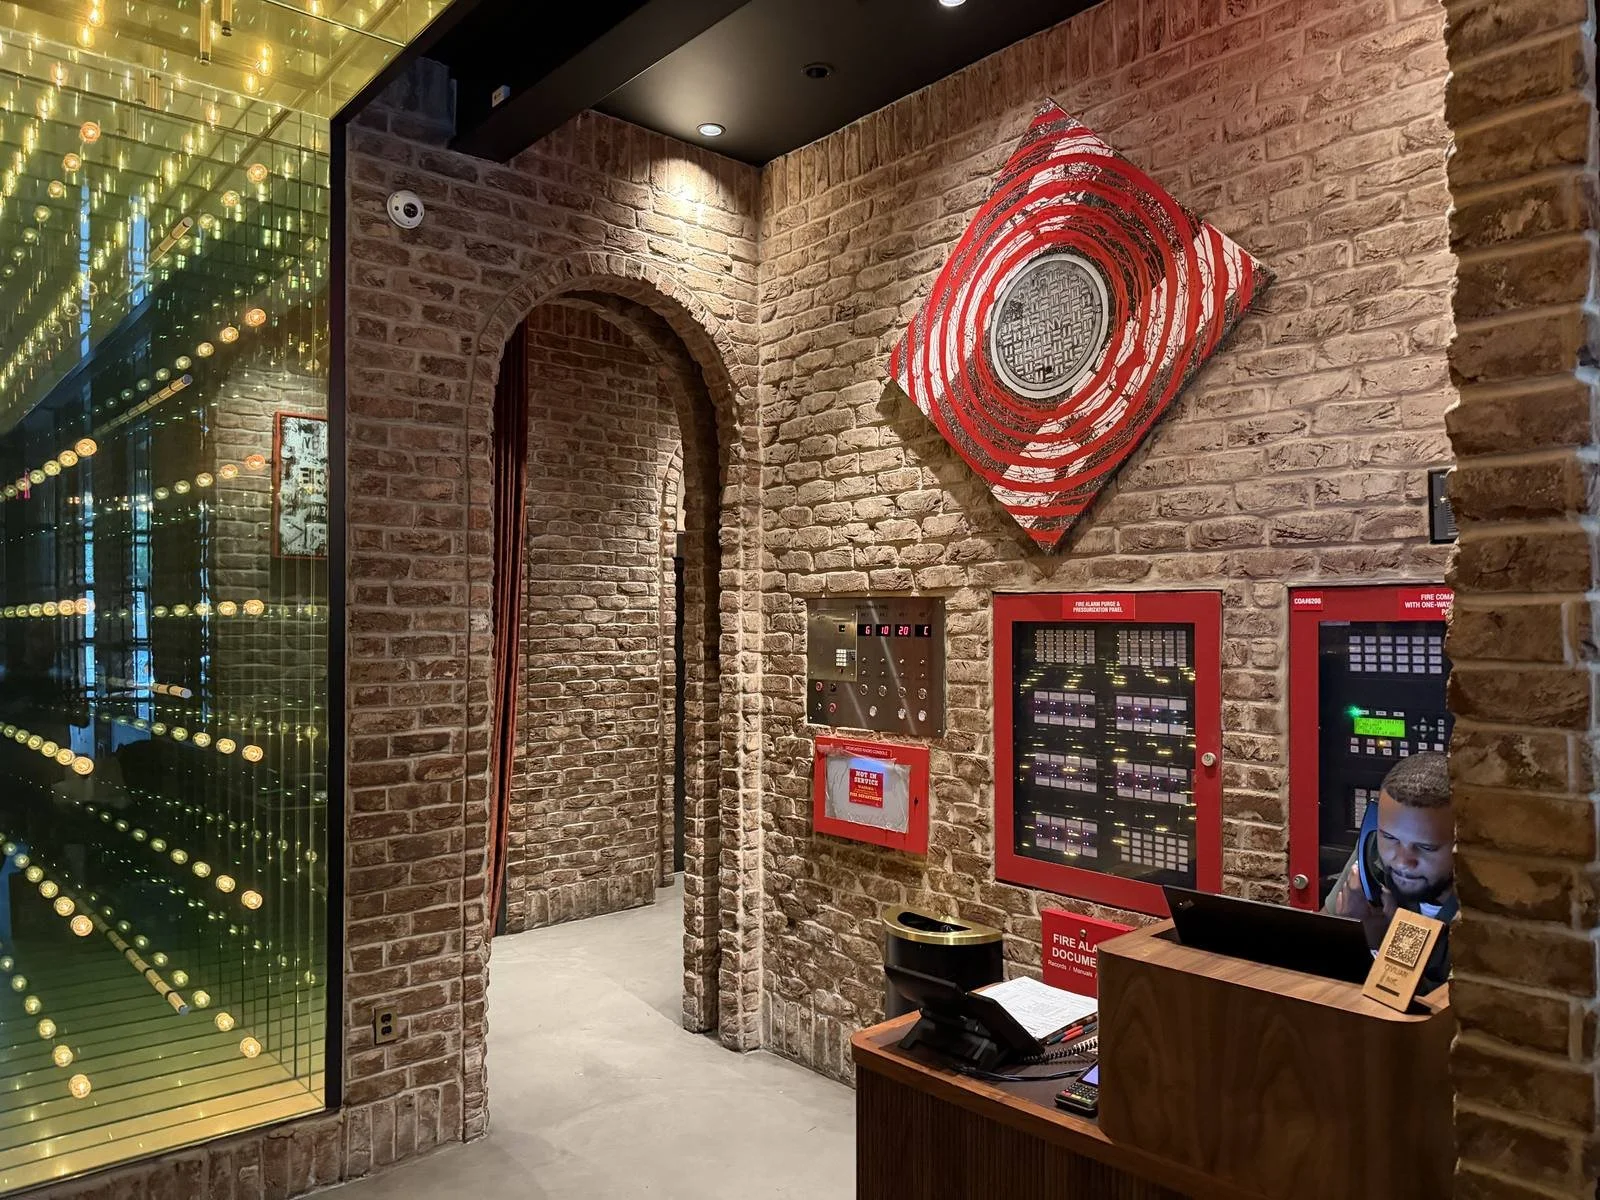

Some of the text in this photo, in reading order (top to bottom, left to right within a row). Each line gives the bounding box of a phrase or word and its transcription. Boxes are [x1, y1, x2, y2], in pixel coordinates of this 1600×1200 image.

[881, 625, 889, 635] 10
[898, 626, 909, 636] 20
[854, 776, 879, 786] SERVICE
[1053, 933, 1076, 949] FIRE
[1052, 947, 1097, 968] DOCUME
[1047, 959, 1067, 970] Records
[1073, 966, 1093, 978] Manuals
